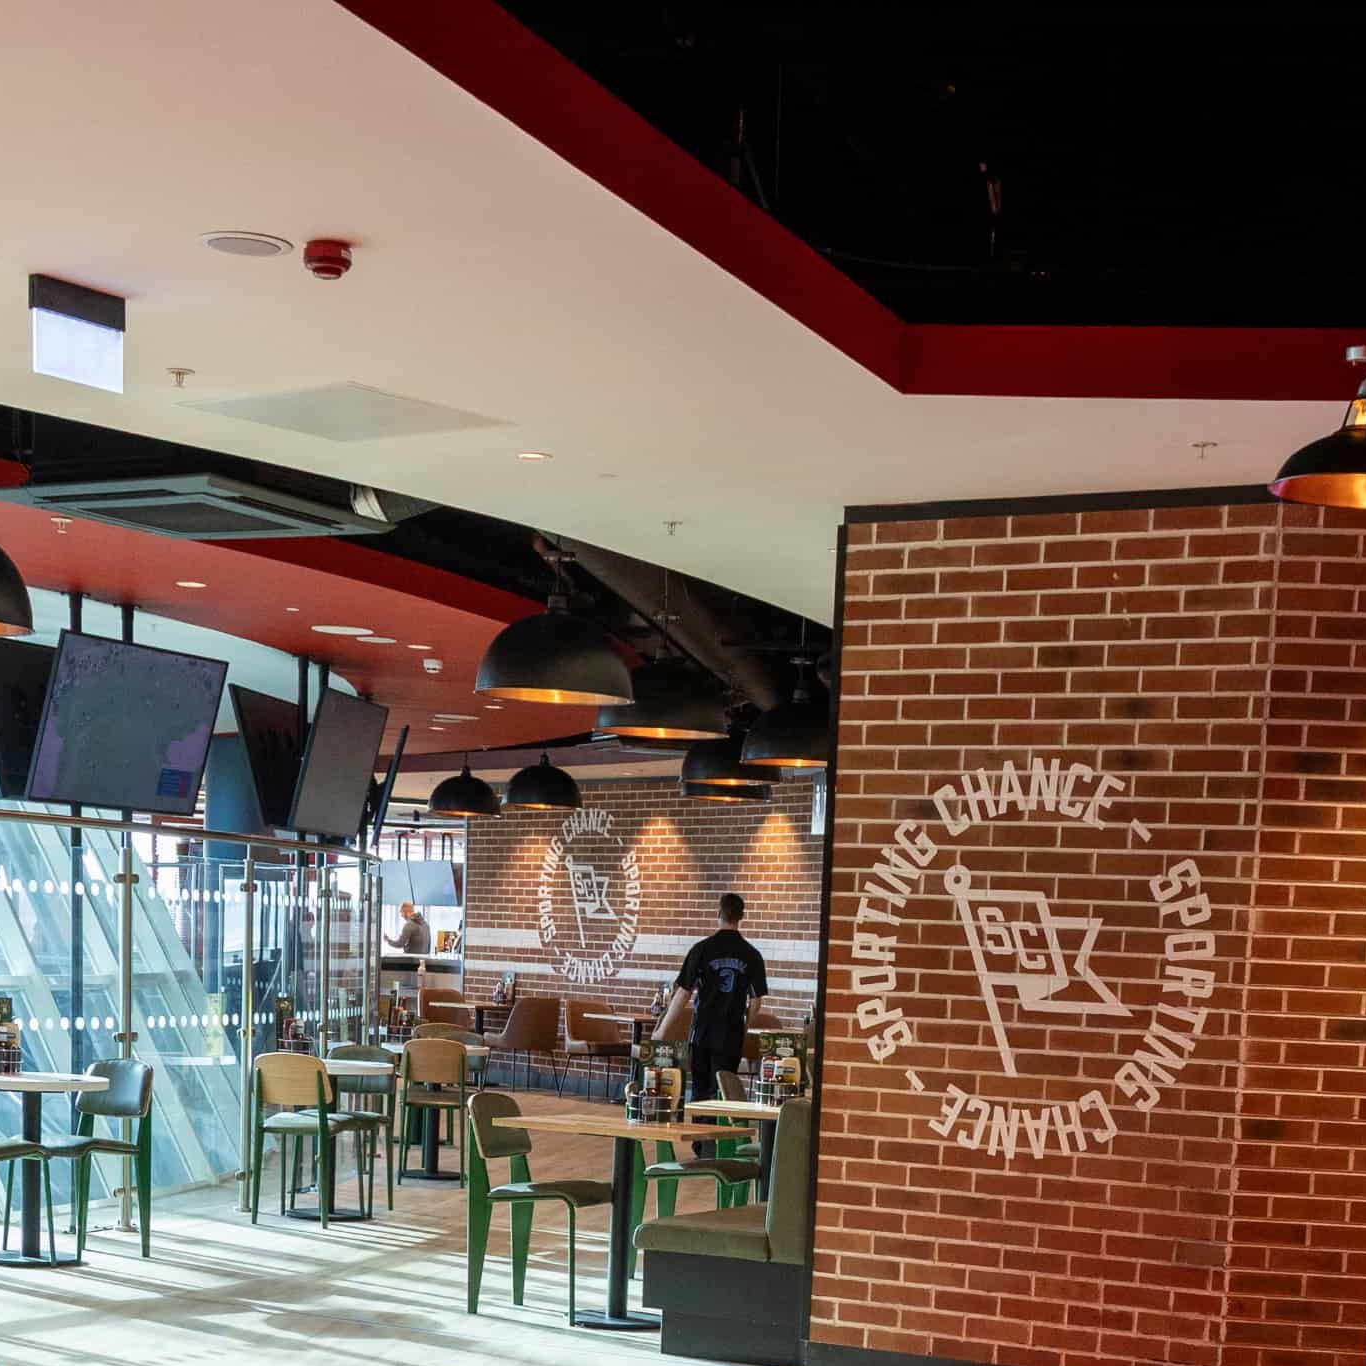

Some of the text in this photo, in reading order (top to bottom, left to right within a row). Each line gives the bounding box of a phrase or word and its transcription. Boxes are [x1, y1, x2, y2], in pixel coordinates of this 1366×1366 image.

[538, 807, 615, 944] SPORTING CHANCE
[561, 849, 641, 985] SPORTING CHANCE
[851, 757, 1126, 1062] SPORTING CHANCE
[719, 968, 735, 993] 3
[928, 858, 1216, 1160] SPORTING CHANCE
